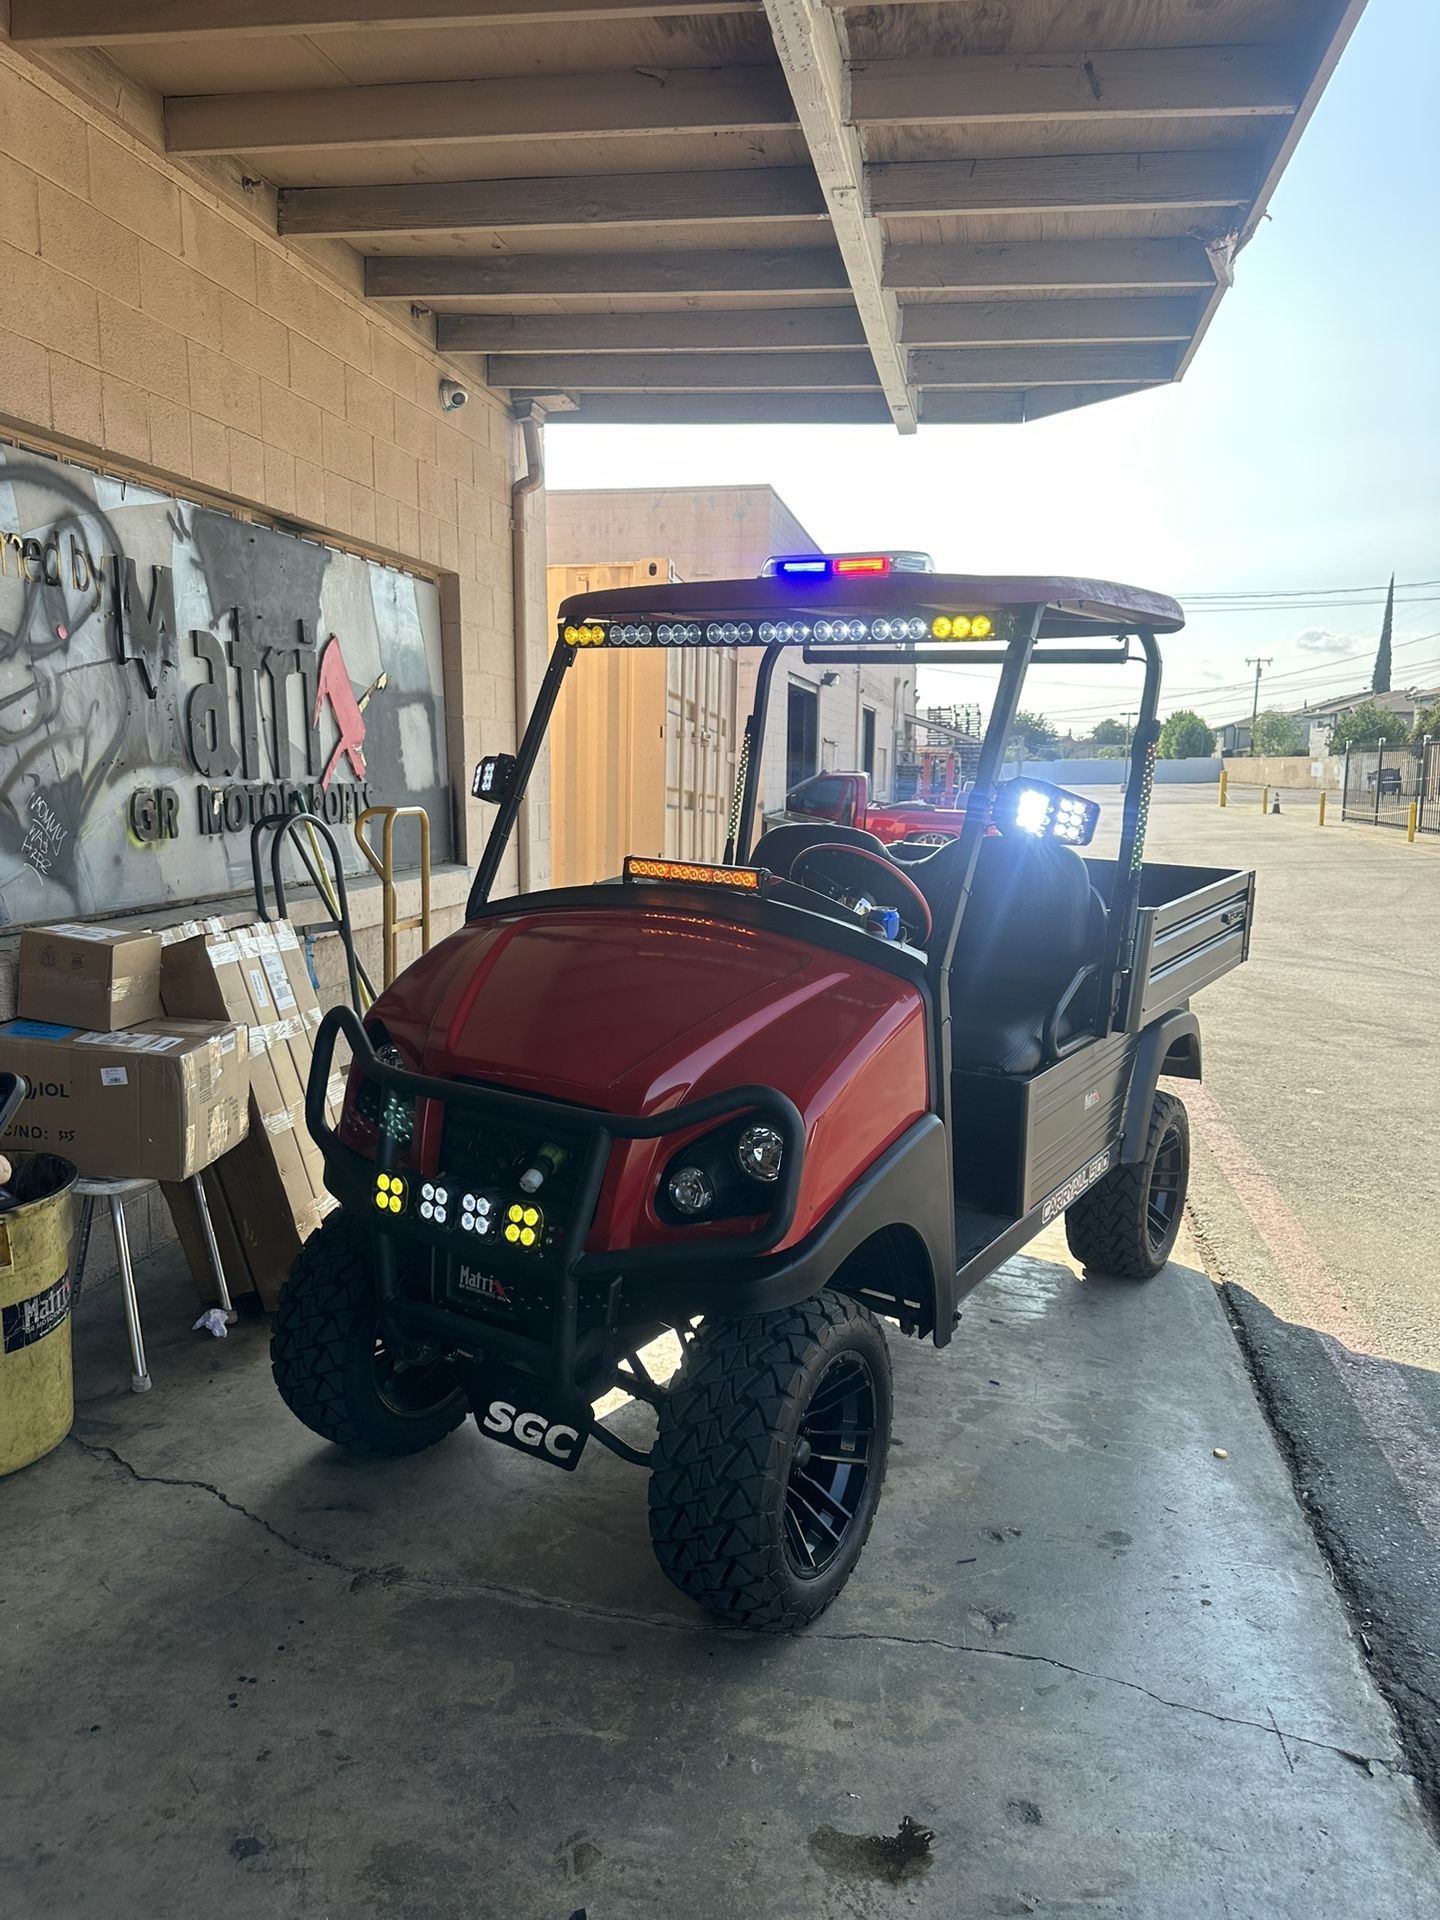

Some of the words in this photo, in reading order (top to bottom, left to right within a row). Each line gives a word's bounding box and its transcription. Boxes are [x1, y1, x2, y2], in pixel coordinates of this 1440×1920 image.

[70, 533, 105, 613] by
[130, 786, 180, 842] GR
[483, 1401, 579, 1459] SGC
